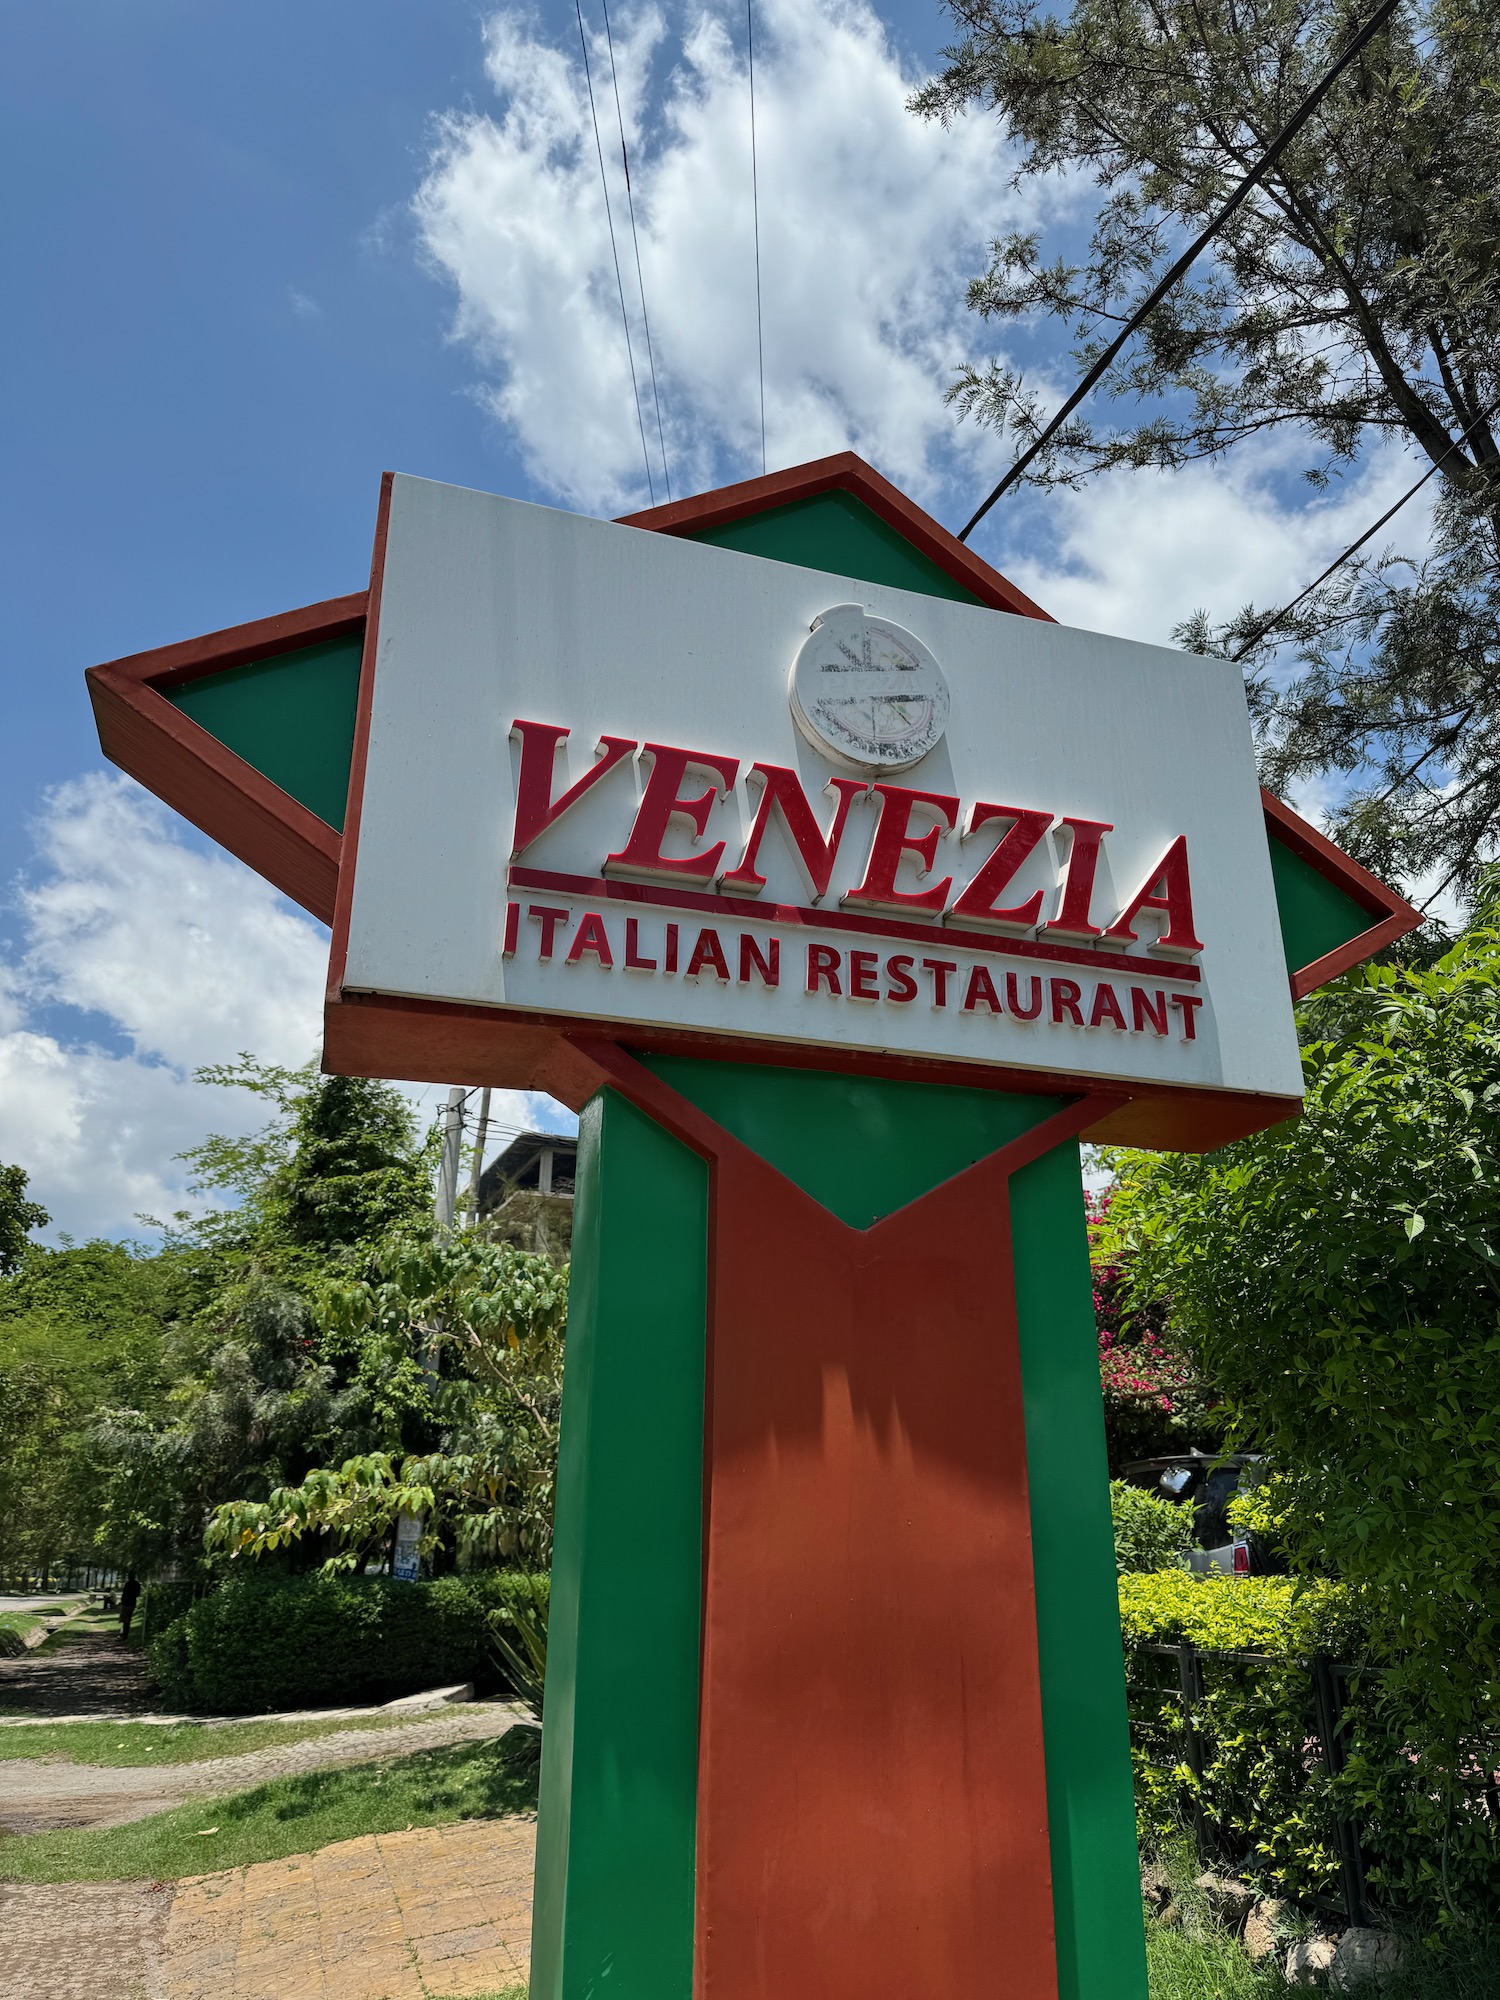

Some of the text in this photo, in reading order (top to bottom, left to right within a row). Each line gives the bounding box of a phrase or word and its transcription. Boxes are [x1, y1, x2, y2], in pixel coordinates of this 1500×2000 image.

[509, 718, 1206, 954] VENEZIA
[503, 901, 1203, 1042] ITALIAN RESTAURANT
